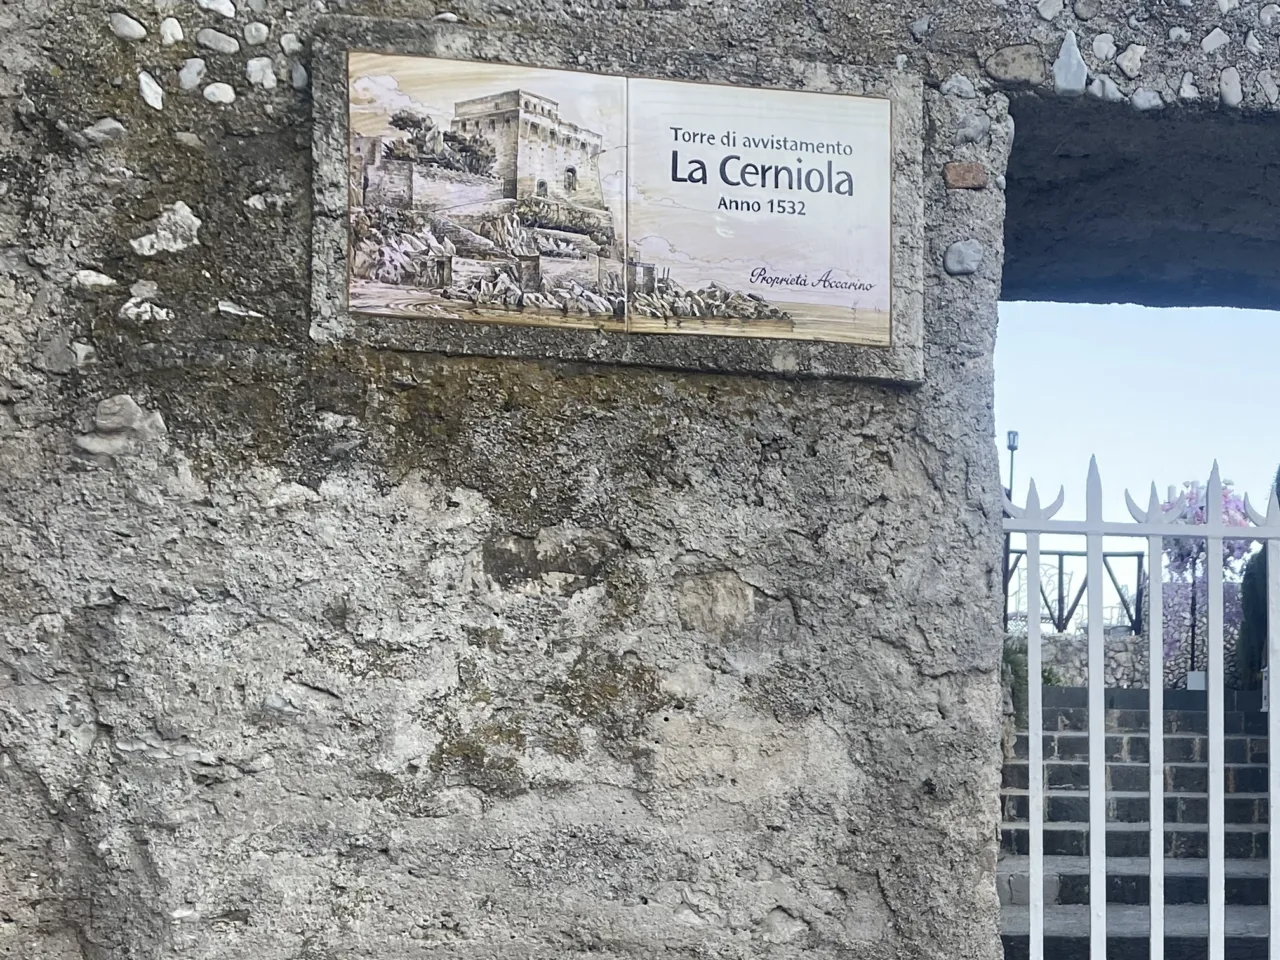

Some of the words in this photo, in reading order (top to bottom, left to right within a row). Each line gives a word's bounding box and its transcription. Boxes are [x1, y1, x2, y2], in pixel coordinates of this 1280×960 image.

[669, 126, 716, 146] Torre
[720, 130, 737, 148] di
[742, 134, 853, 156] avvistamento
[671, 149, 708, 185] La
[718, 154, 854, 197] Cerniola
[717, 196, 761, 213] Anno
[767, 198, 806, 216] 1532
[749, 266, 809, 288] Proprietà
[811, 268, 877, 291] Accarino
